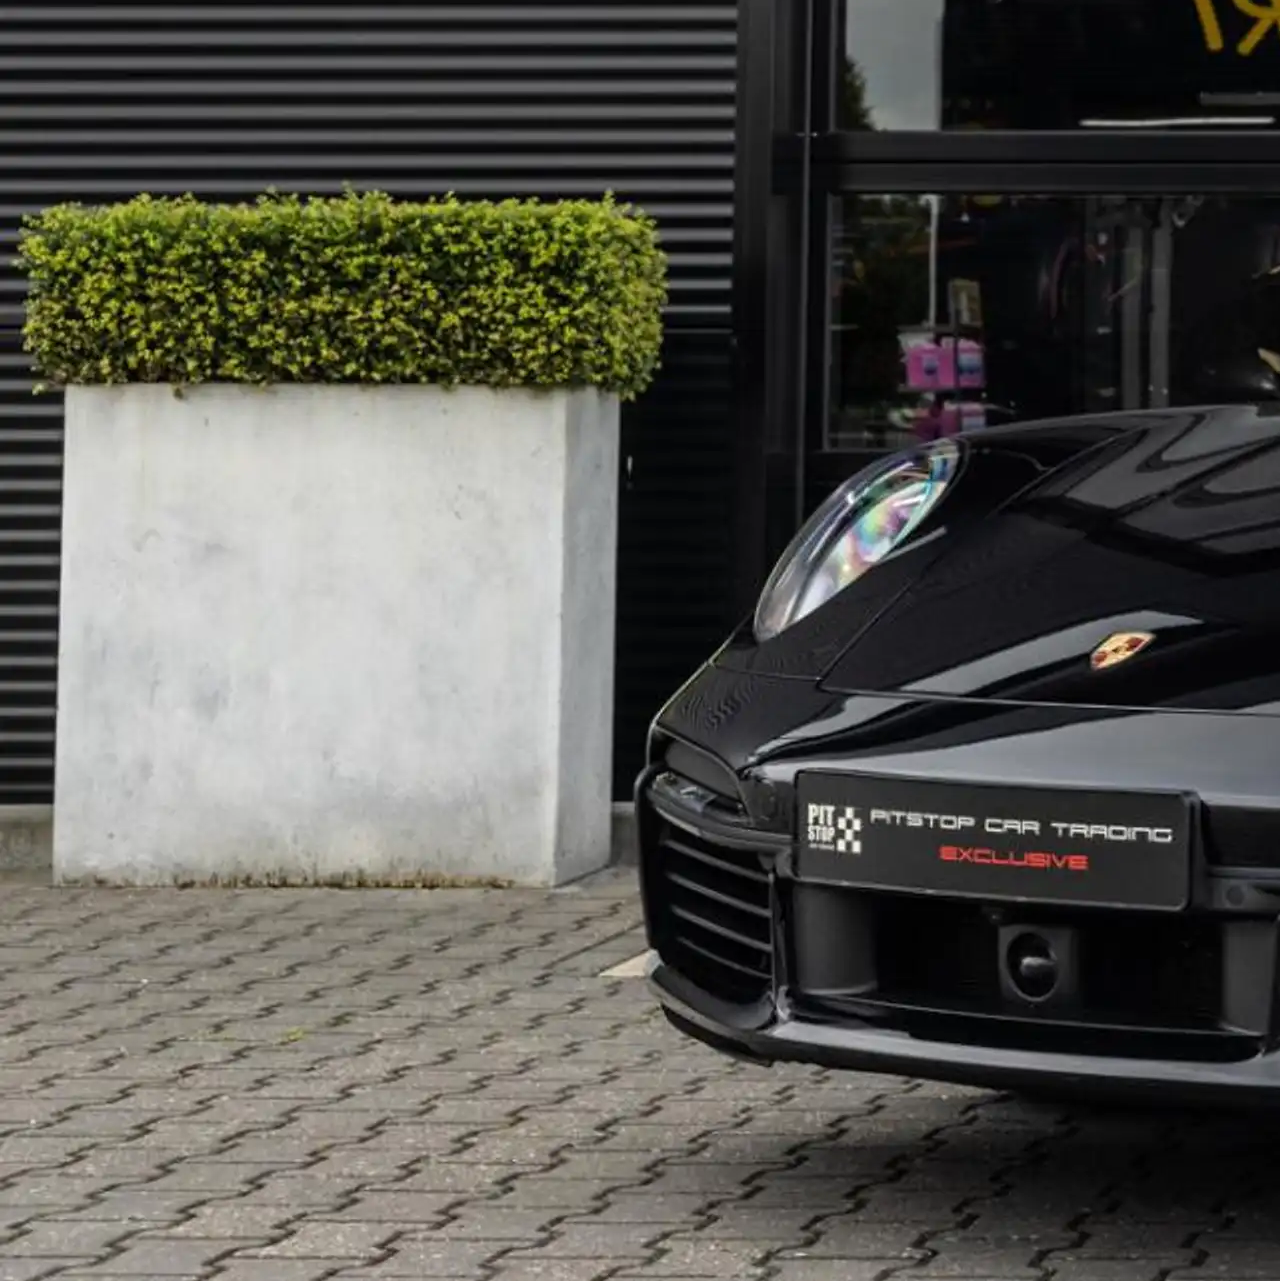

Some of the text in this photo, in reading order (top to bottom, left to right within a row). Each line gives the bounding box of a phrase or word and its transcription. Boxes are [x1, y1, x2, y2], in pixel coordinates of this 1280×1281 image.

[807, 802, 836, 826] PIT
[870, 808, 1174, 844] PITSTOP CAR TRADING
[807, 825, 836, 843] STOP
[938, 846, 1090, 871] EXCLUSIVE
